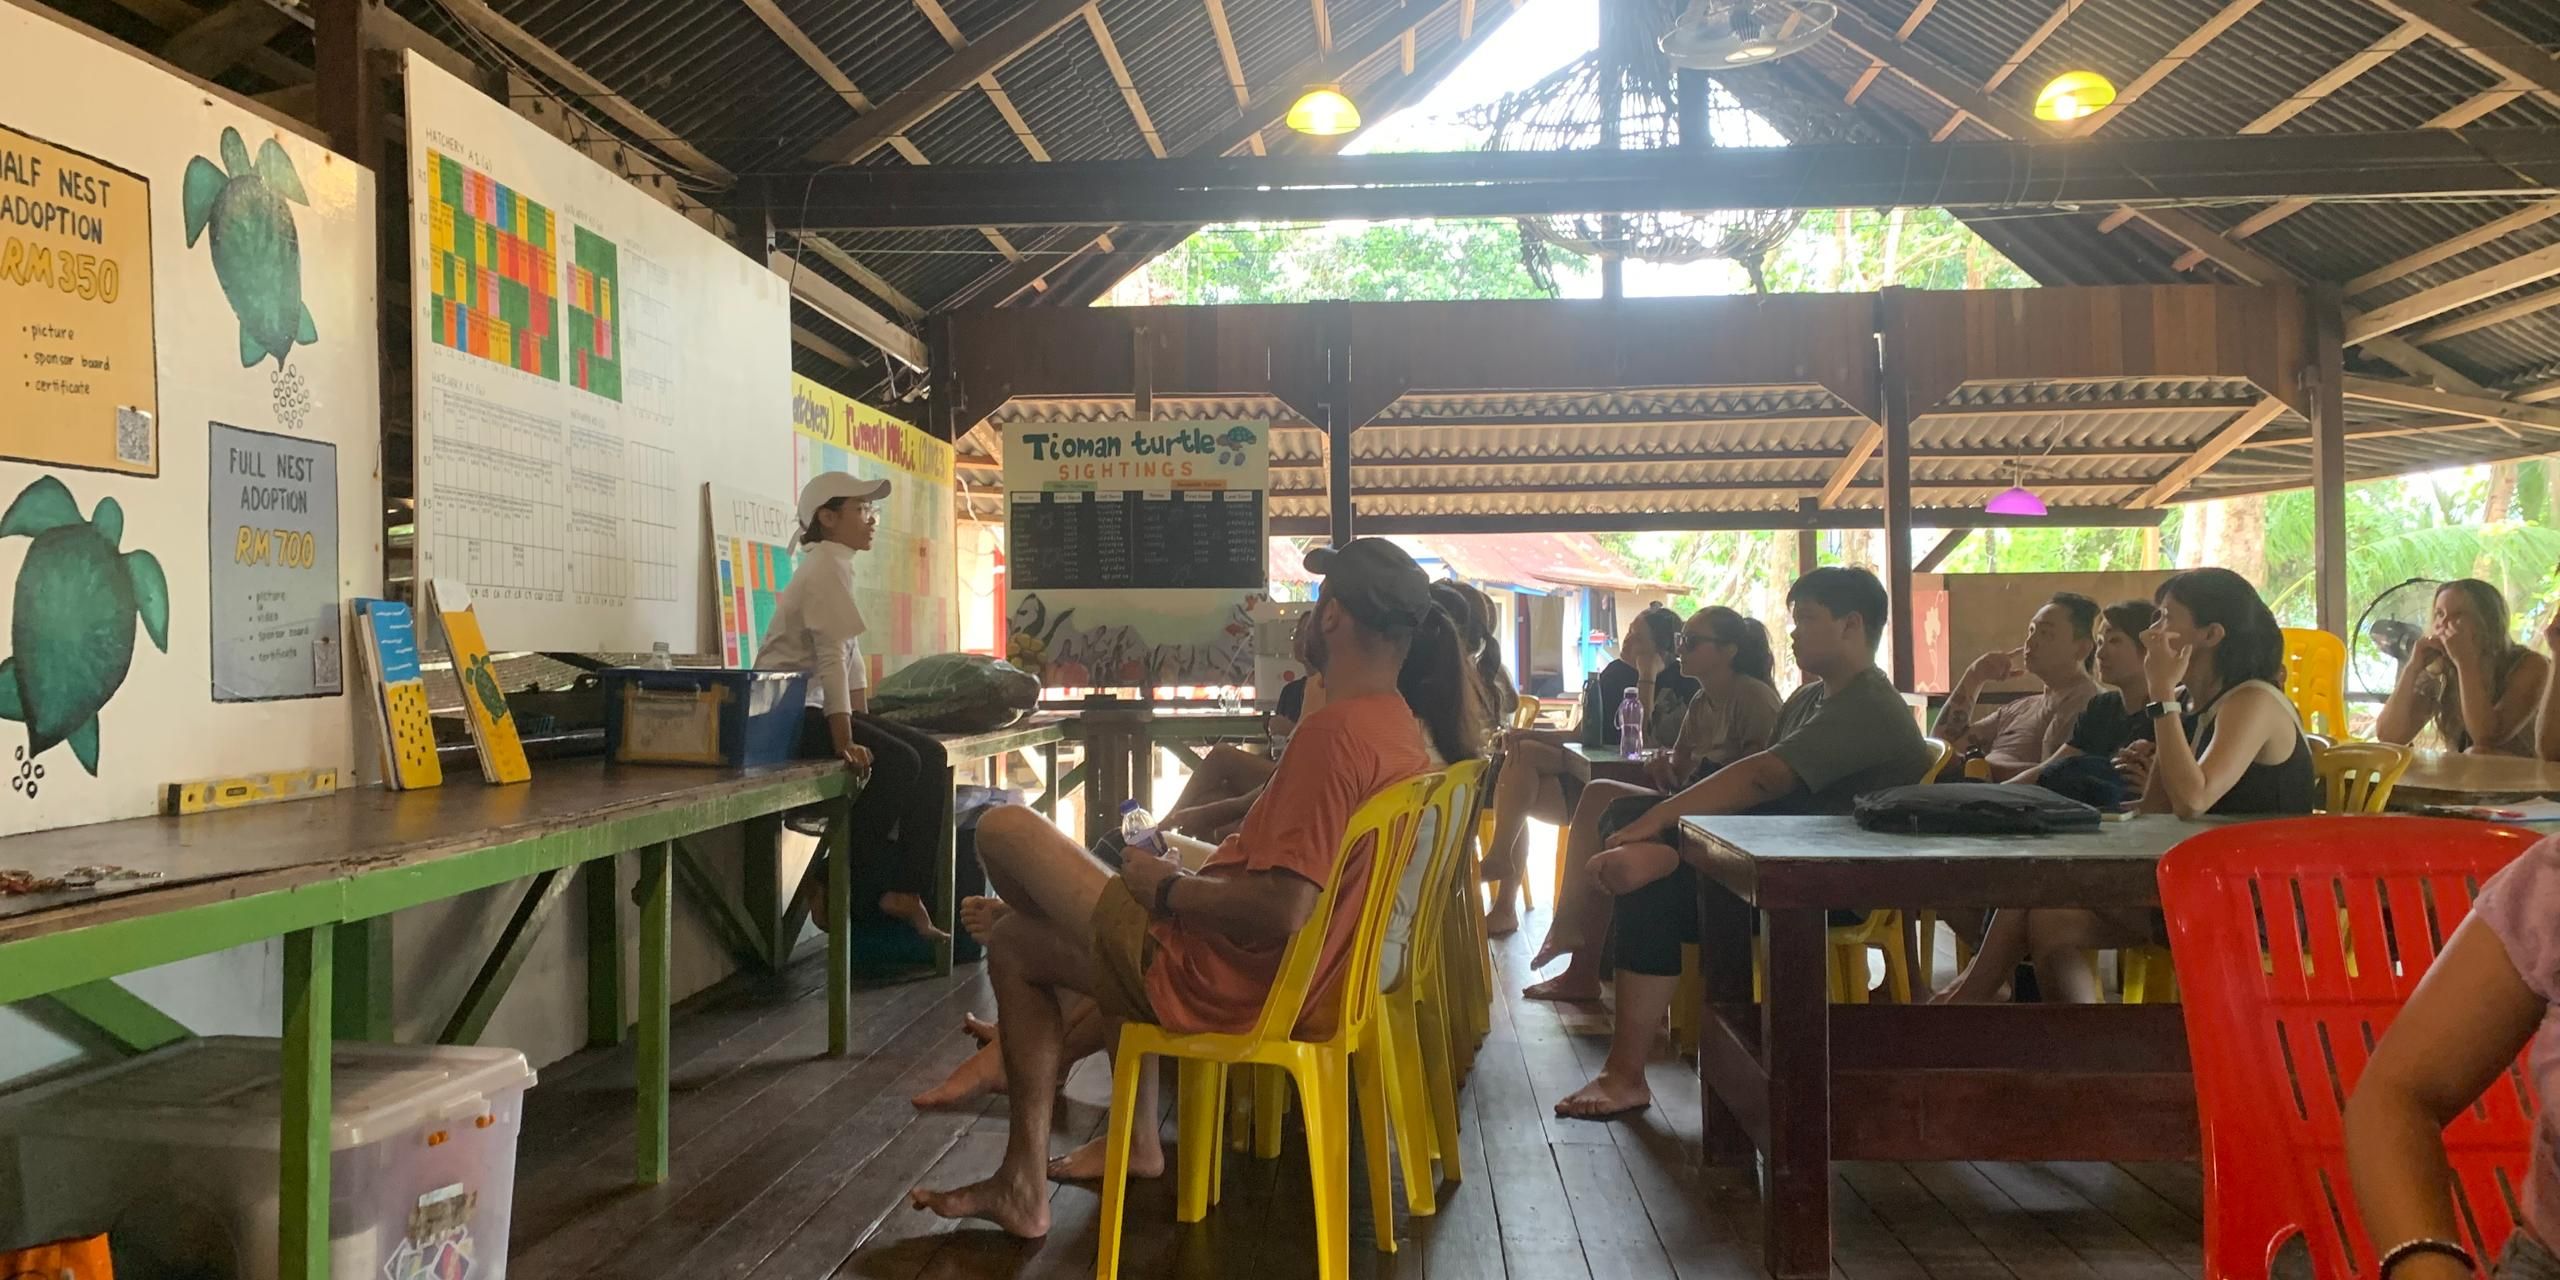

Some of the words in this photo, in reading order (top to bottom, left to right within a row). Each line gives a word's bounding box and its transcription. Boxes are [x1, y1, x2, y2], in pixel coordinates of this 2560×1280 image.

[426, 128, 464, 154] HATCHERY
[0, 149, 41, 188] ALF
[59, 168, 110, 208] NEST
[0, 195, 102, 244] ADOPTION
[31, 323, 74, 341] picture
[34, 351, 74, 366] sponsor
[81, 354, 110, 371] board
[35, 378, 90, 395] certificate
[1022, 433, 1122, 460] Tioman
[1131, 428, 1216, 456] turtle
[230, 447, 266, 478] FULL
[277, 453, 314, 482] NEST
[1059, 461, 1193, 480] SIGHTINGS
[241, 485, 307, 514] ADOPTION
[733, 499, 788, 539] HATCHERY
